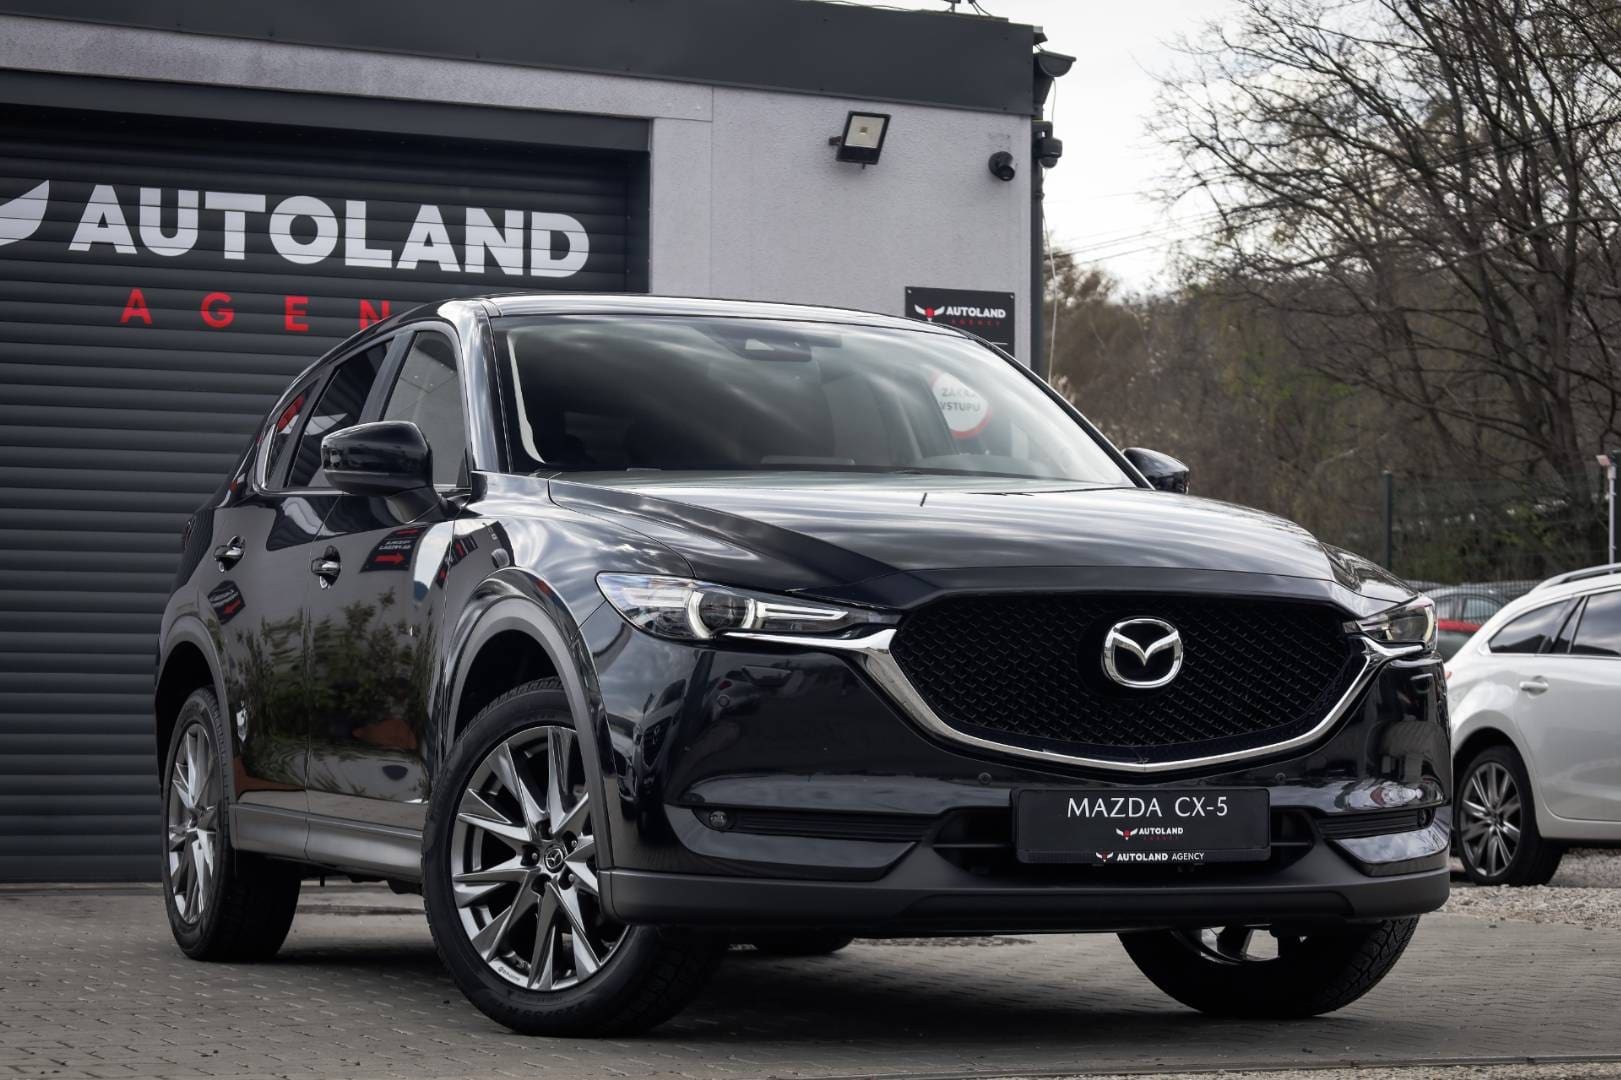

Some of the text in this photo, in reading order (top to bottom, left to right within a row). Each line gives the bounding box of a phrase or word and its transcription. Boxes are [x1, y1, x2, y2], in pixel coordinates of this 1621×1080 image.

[68, 183, 591, 279] AUTOLAND
[945, 305, 1007, 319] AUTOLAND
[1067, 796, 1228, 818] MAZDA CX-5
[1138, 827, 1184, 835] AUTOLAND
[1116, 852, 1205, 862] AUTOLAND AGENCY
